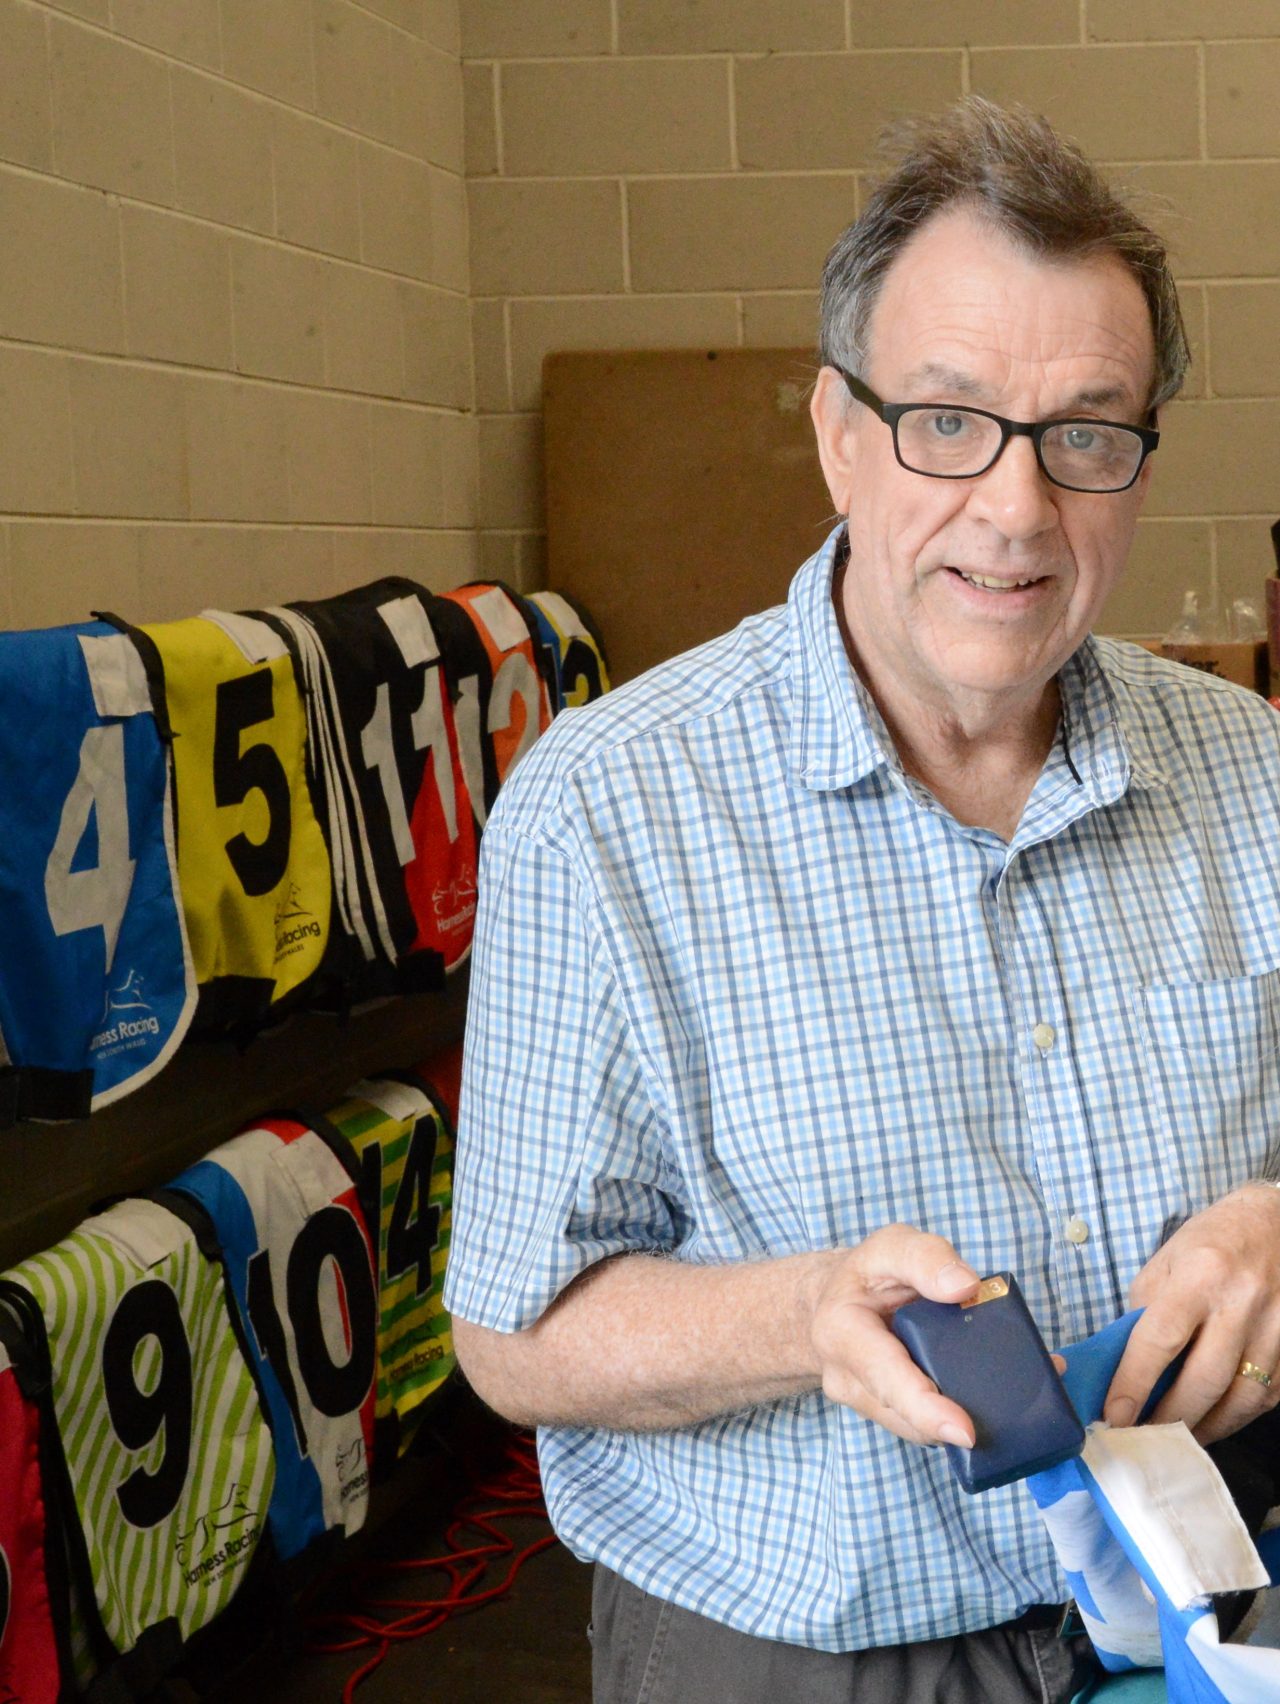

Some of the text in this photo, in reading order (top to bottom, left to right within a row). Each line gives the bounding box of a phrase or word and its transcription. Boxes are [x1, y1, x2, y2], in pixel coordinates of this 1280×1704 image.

[45, 724, 136, 976] 4
[214, 667, 291, 896] 5
[118, 1017, 160, 1039] Racing
[103, 1279, 193, 1529] 9
[246, 1206, 378, 1460] 10
[183, 1550, 227, 1589] Harness
